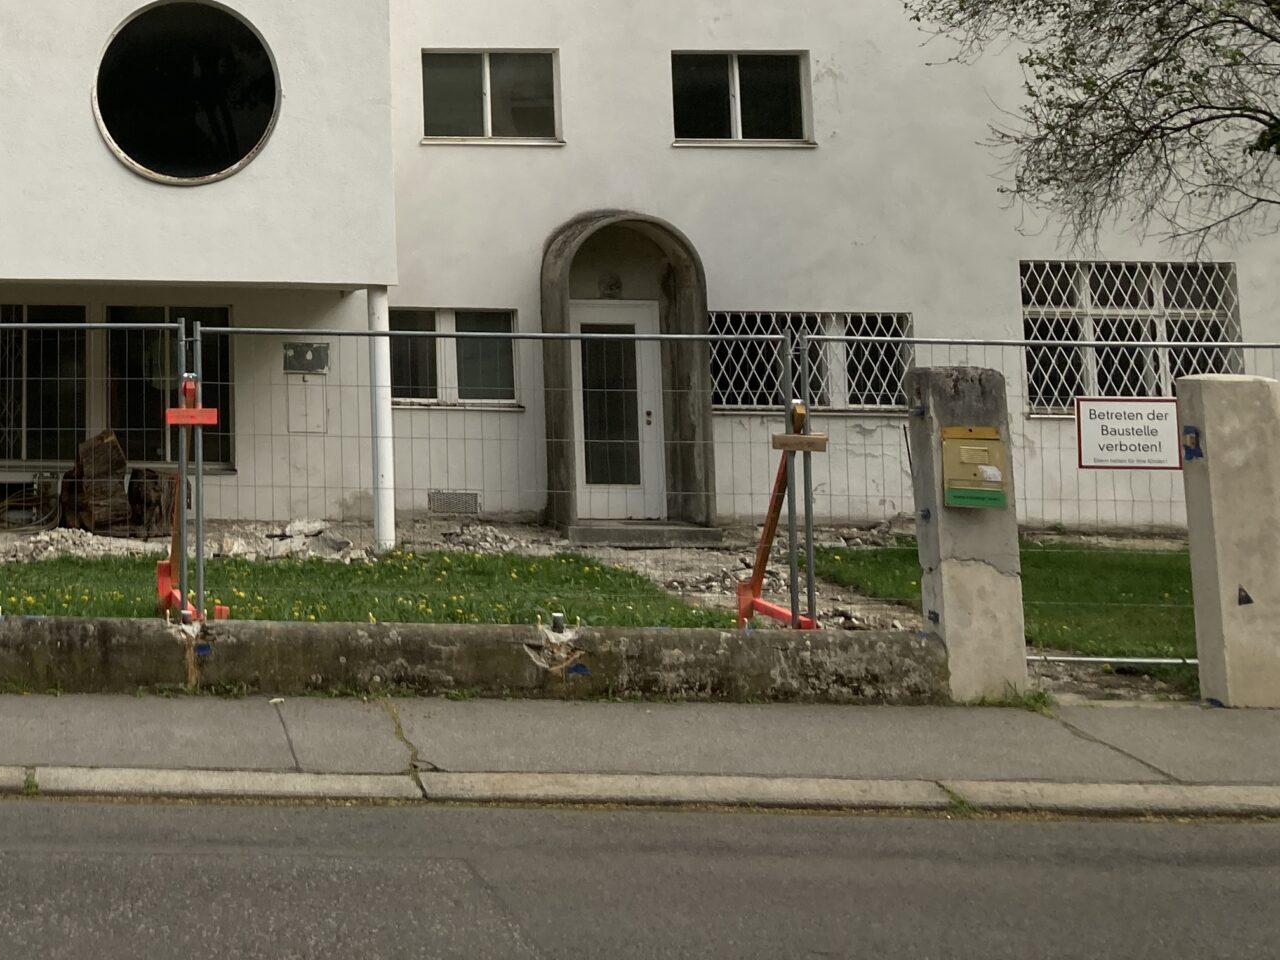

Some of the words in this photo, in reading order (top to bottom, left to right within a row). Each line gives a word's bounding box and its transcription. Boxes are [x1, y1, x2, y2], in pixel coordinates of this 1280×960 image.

[1089, 408, 1143, 420] Betreten
[1147, 409, 1169, 421] der
[1101, 424, 1159, 436] Baustelle
[1098, 441, 1162, 452] verboten!
